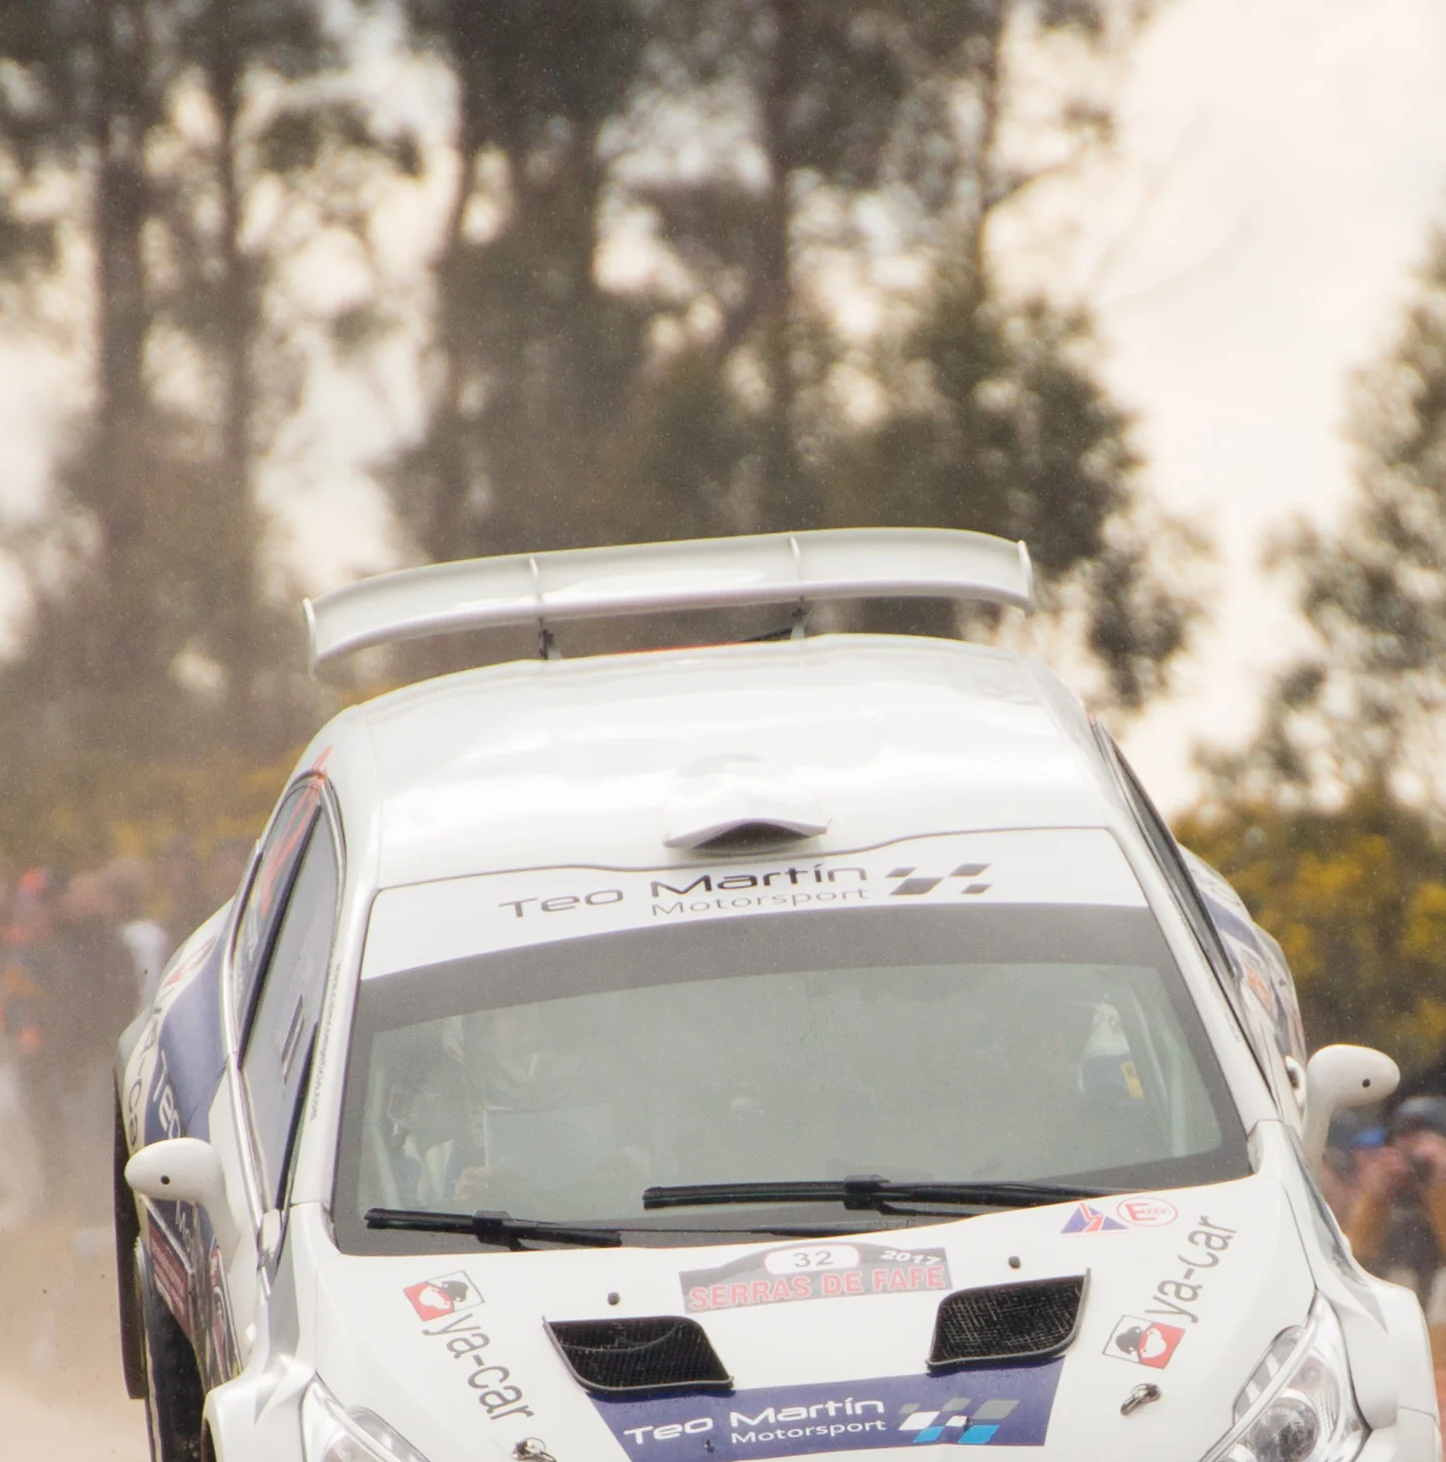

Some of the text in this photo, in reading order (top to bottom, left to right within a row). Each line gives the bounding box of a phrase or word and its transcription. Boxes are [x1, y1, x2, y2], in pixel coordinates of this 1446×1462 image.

[498, 863, 868, 919] Teo Martín
[651, 886, 870, 918] Motorsport
[792, 1250, 835, 1269] 32
[880, 1249, 942, 1266] 2017
[1144, 1214, 1239, 1325] ya-car
[688, 1265, 946, 1311] SERRAS DE FAFE
[421, 1312, 535, 1420] ya-car
[623, 1397, 885, 1446] Teo Martín
[730, 1419, 887, 1445] Motorsport
